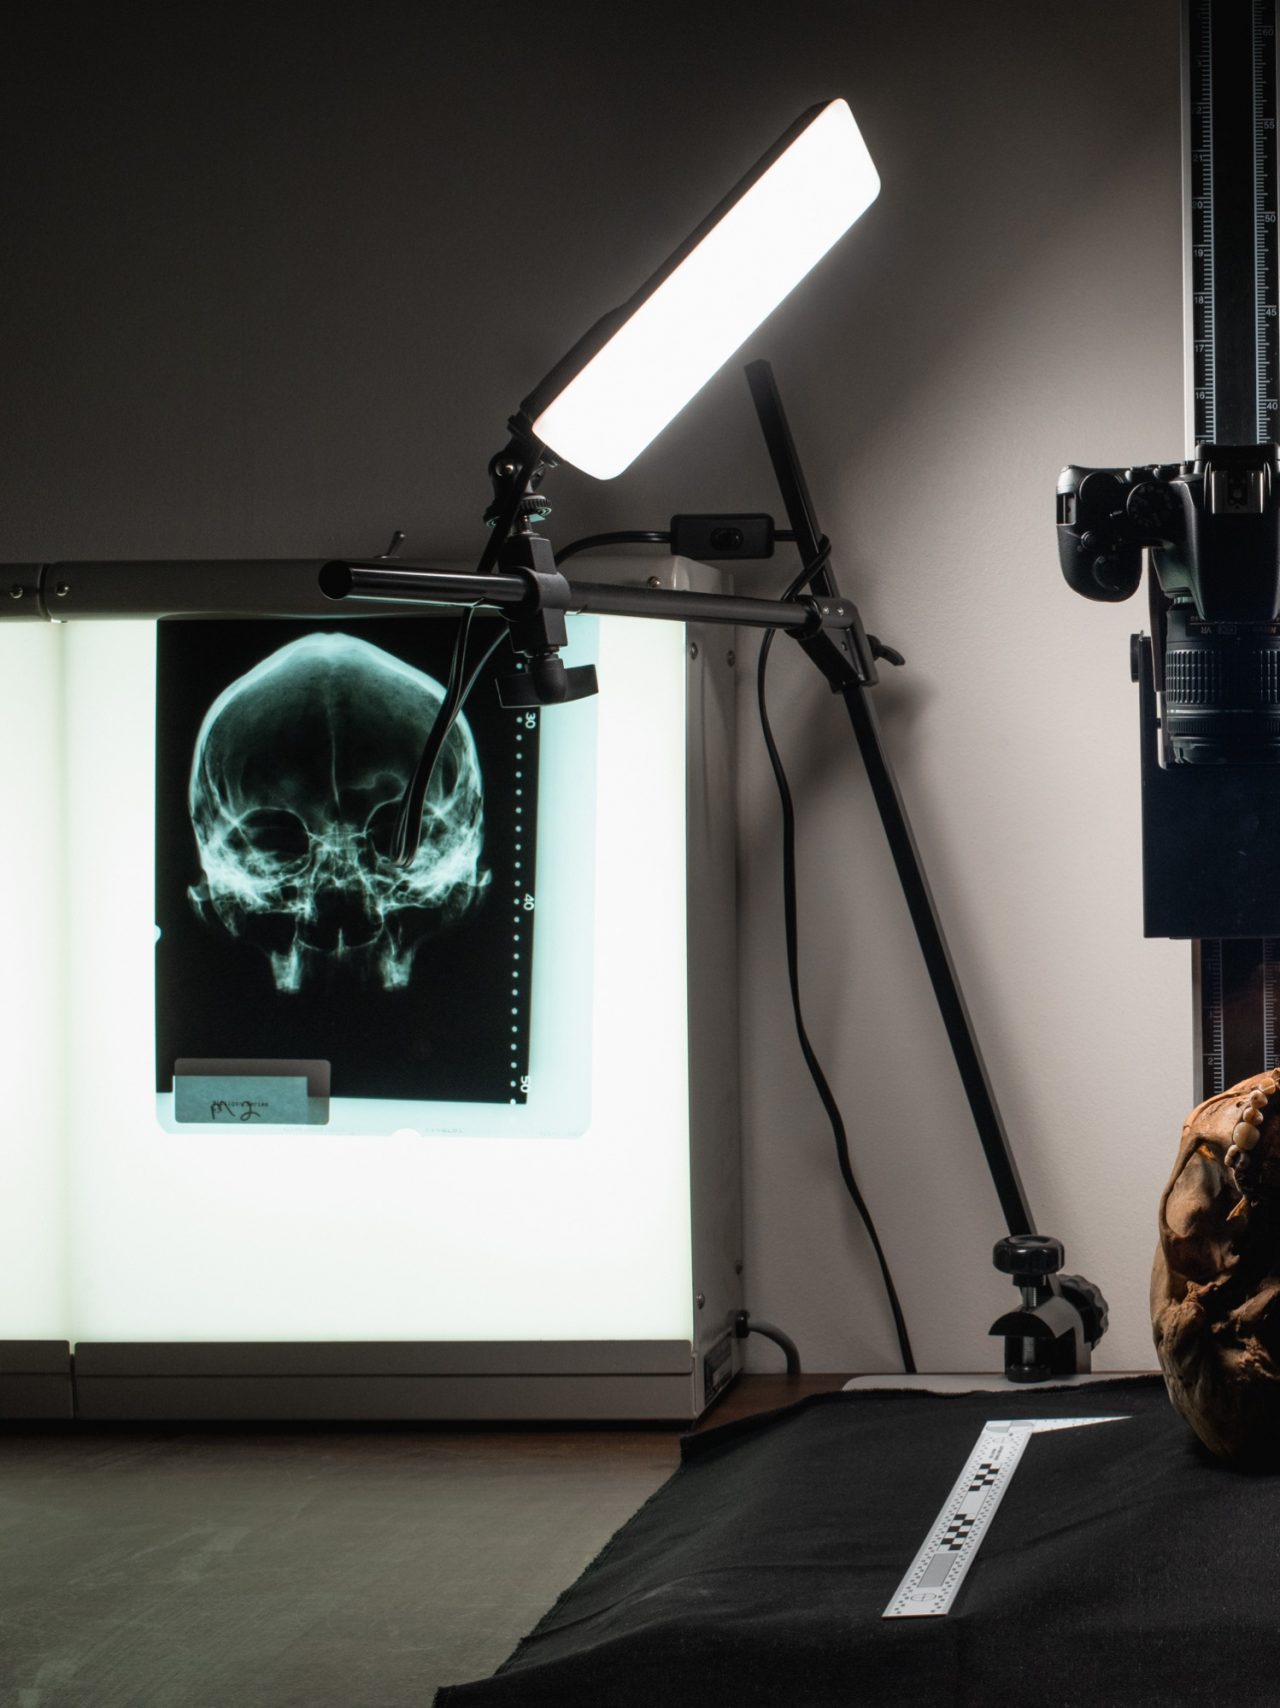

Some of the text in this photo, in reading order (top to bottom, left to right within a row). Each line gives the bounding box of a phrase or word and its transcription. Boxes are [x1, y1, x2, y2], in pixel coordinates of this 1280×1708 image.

[1263, 121, 1275, 130] 55
[1264, 214, 1276, 223] 50
[1193, 248, 1204, 258] 19
[1194, 295, 1204, 305] 18
[1265, 308, 1277, 317] 45
[1194, 344, 1204, 353] 17
[1195, 391, 1206, 400] 16
[1266, 402, 1278, 411] 40
[525, 711, 537, 729] 30
[523, 893, 535, 911] 40
[1207, 1057, 1214, 1065] 2
[520, 1074, 532, 1093] 50
